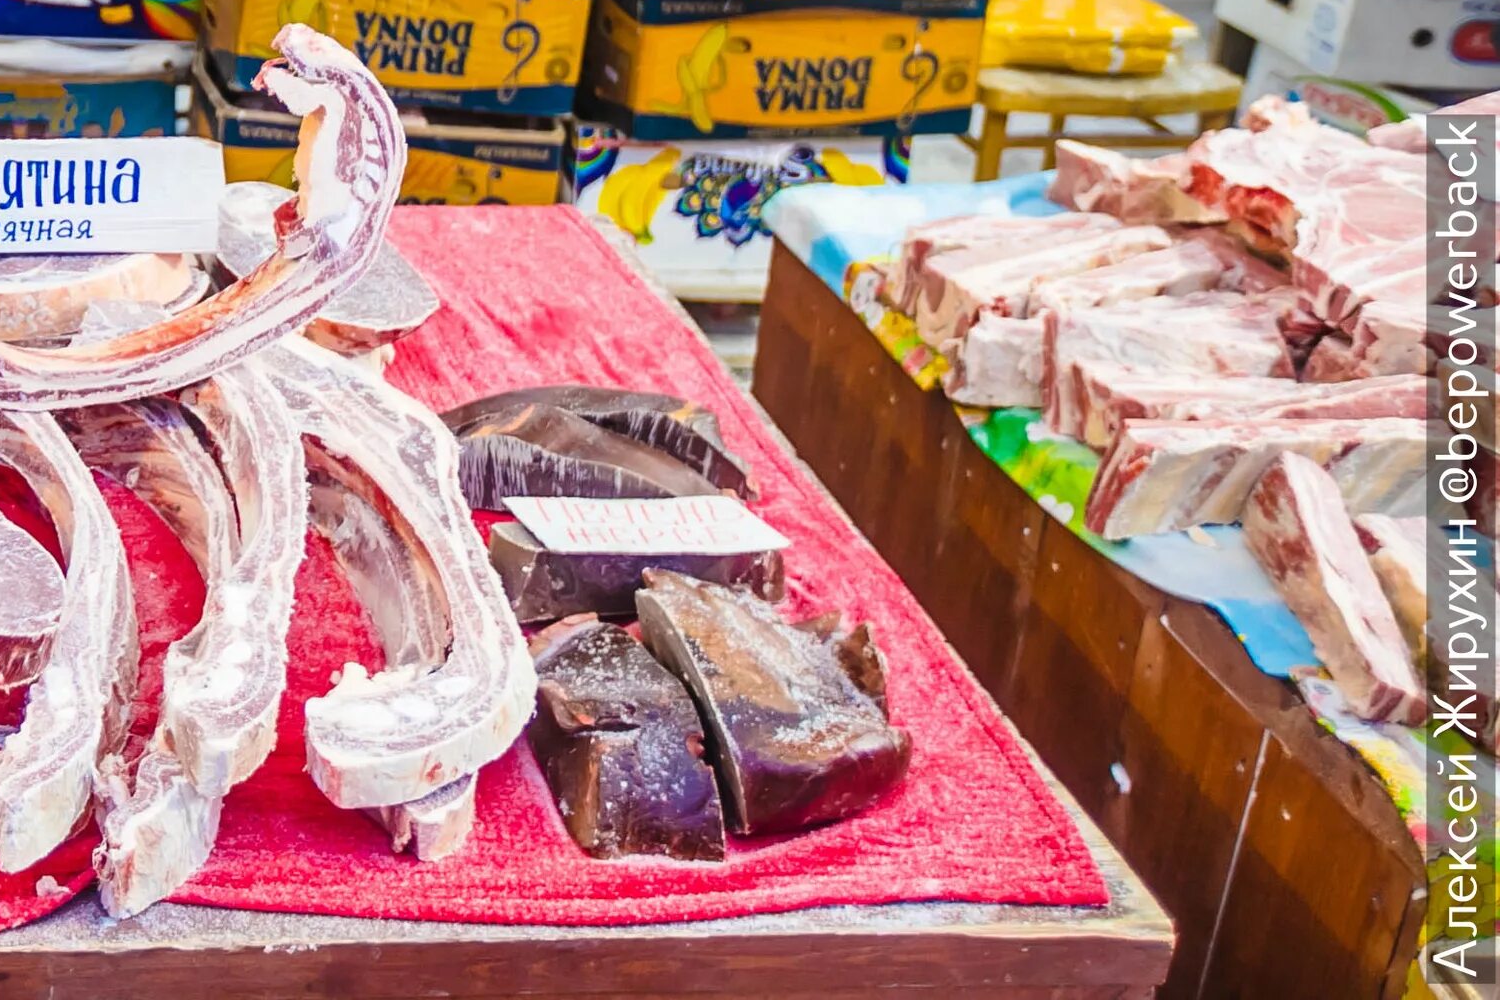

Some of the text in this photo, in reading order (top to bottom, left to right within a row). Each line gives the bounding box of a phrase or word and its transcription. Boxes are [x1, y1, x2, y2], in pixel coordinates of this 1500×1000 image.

[353, 10, 475, 49] DONNA
[353, 39, 469, 77] PRIMA
[754, 56, 875, 87] DONNA
[754, 85, 868, 114] PRIMA
